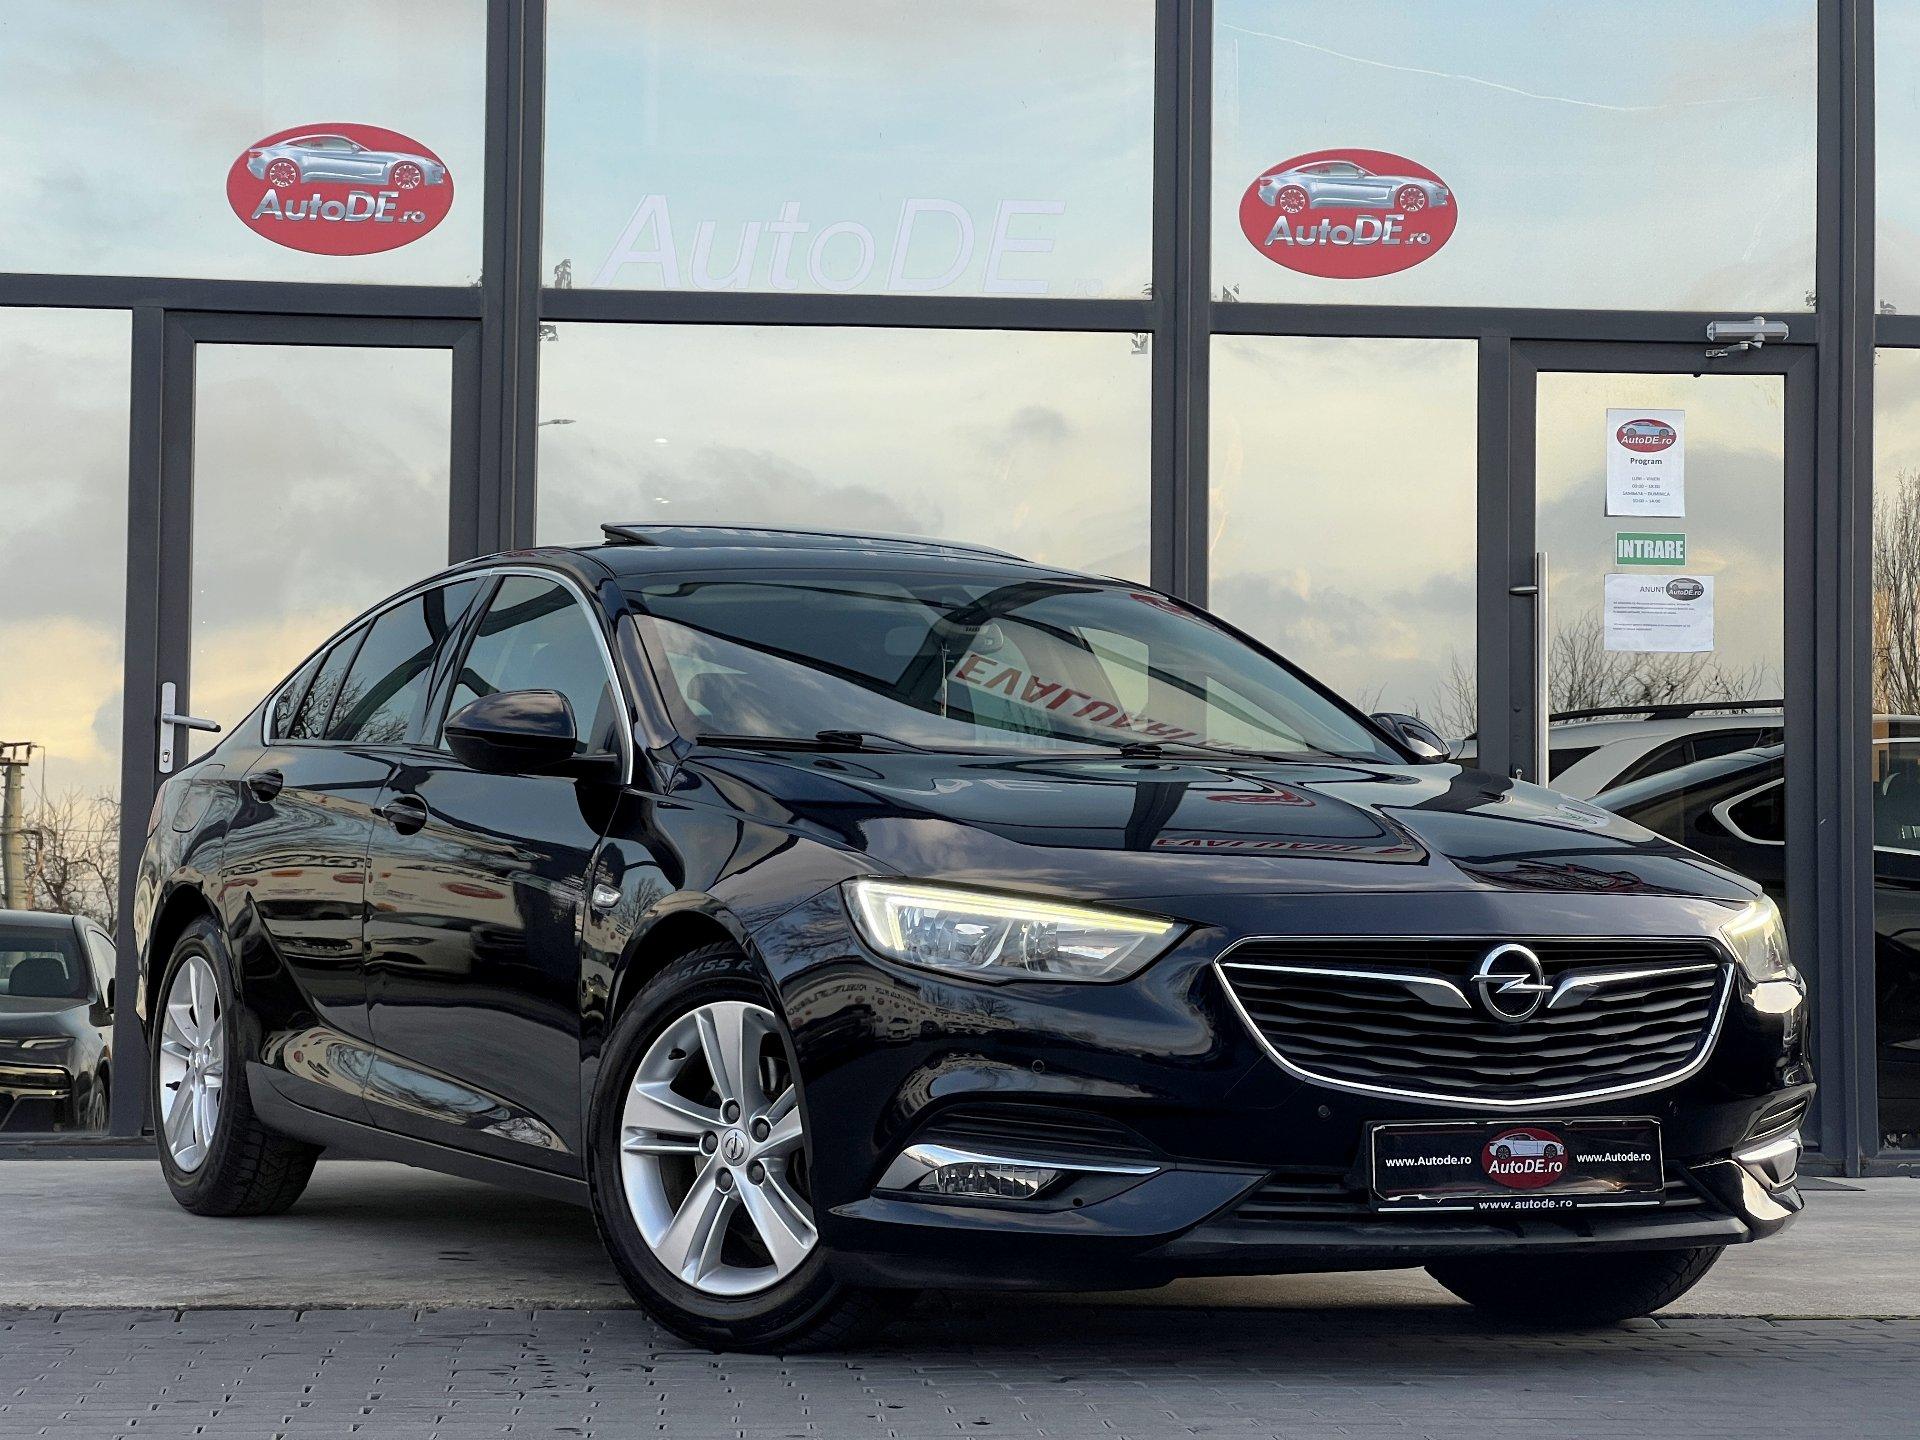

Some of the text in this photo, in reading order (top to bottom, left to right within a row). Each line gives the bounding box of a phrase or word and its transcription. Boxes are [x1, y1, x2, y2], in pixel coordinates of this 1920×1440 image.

[251, 188, 426, 223] AutoDE.ro
[1264, 213, 1431, 246] AutoDE.ro
[1621, 436, 1672, 445] AutoDE.ro
[1630, 457, 1662, 465] Program
[1618, 540, 1684, 558] INTRARE
[1385, 1155, 1472, 1167] www.Autode.ro
[1576, 1151, 1651, 1163] www.Autode.ro
[1488, 1158, 1563, 1175] AutoDE.ro
[1479, 1198, 1573, 1210] www.autode.ro
